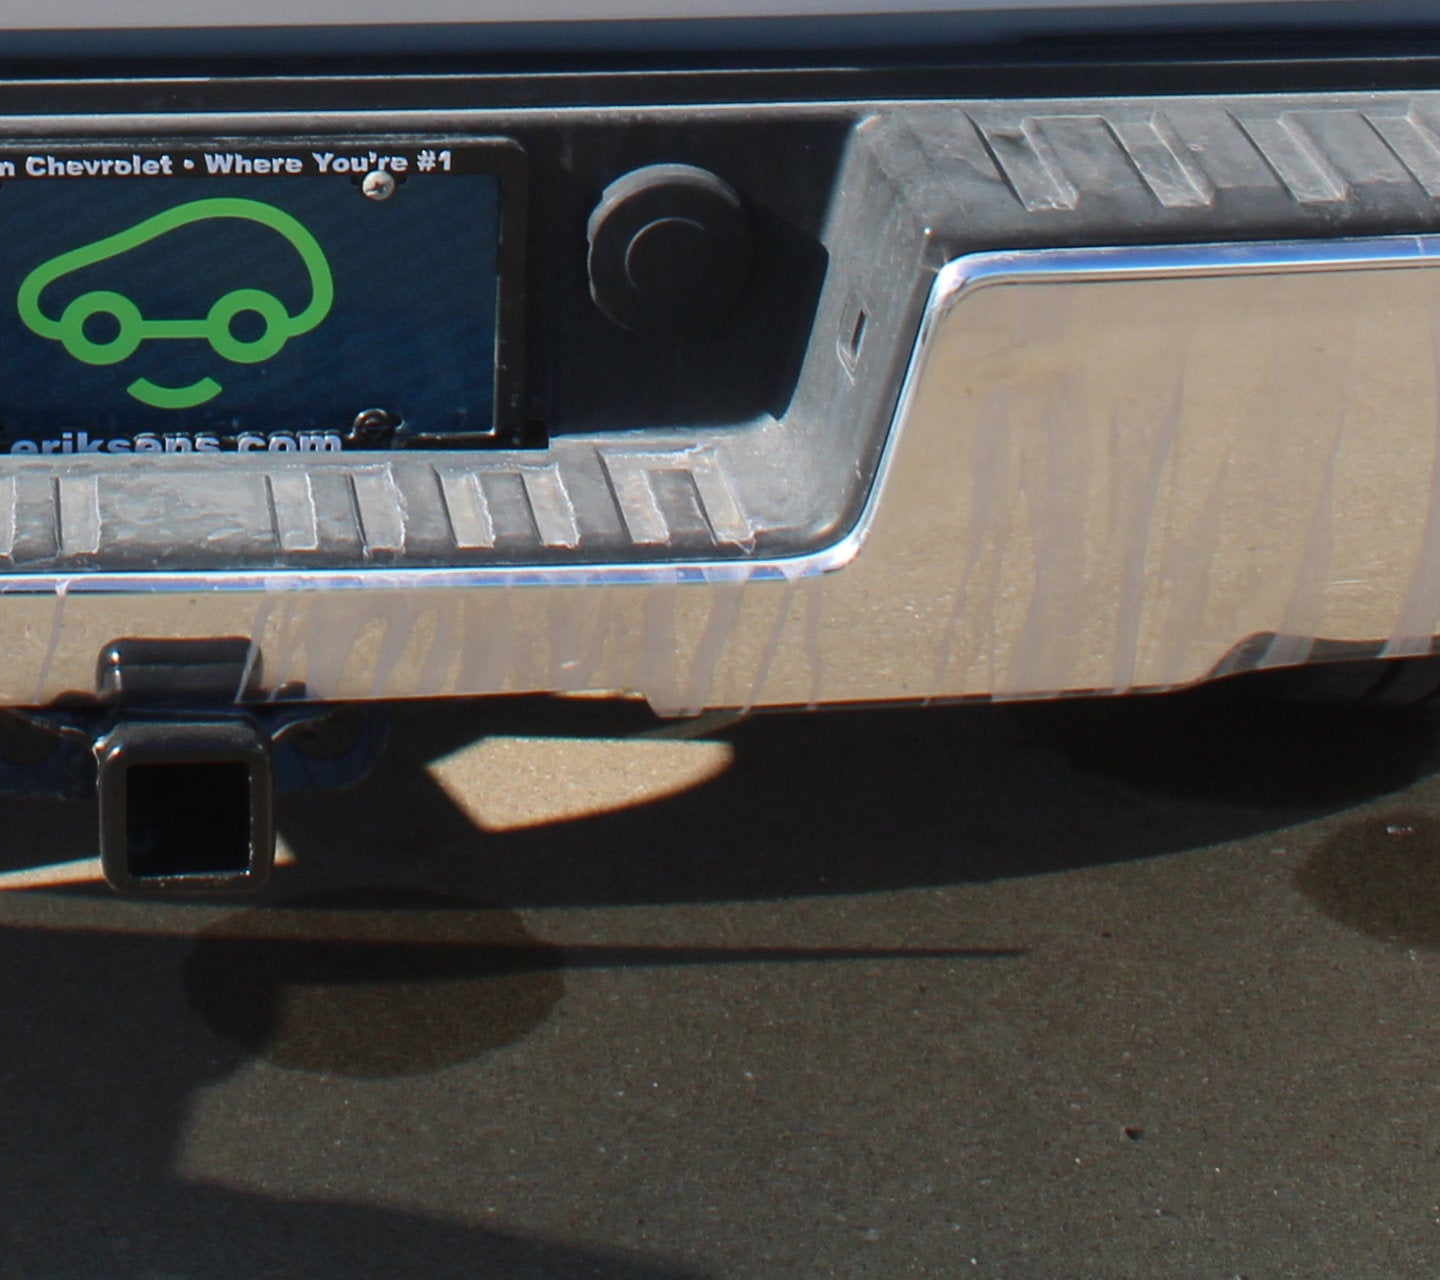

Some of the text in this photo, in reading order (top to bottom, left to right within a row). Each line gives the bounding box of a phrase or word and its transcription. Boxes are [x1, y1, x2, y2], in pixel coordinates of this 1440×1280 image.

[25, 154, 174, 177] Chevrolet
[204, 152, 303, 174] Where
[312, 151, 408, 173] You're
[417, 149, 452, 172] #1
[9, 430, 343, 455] eriksenscom
